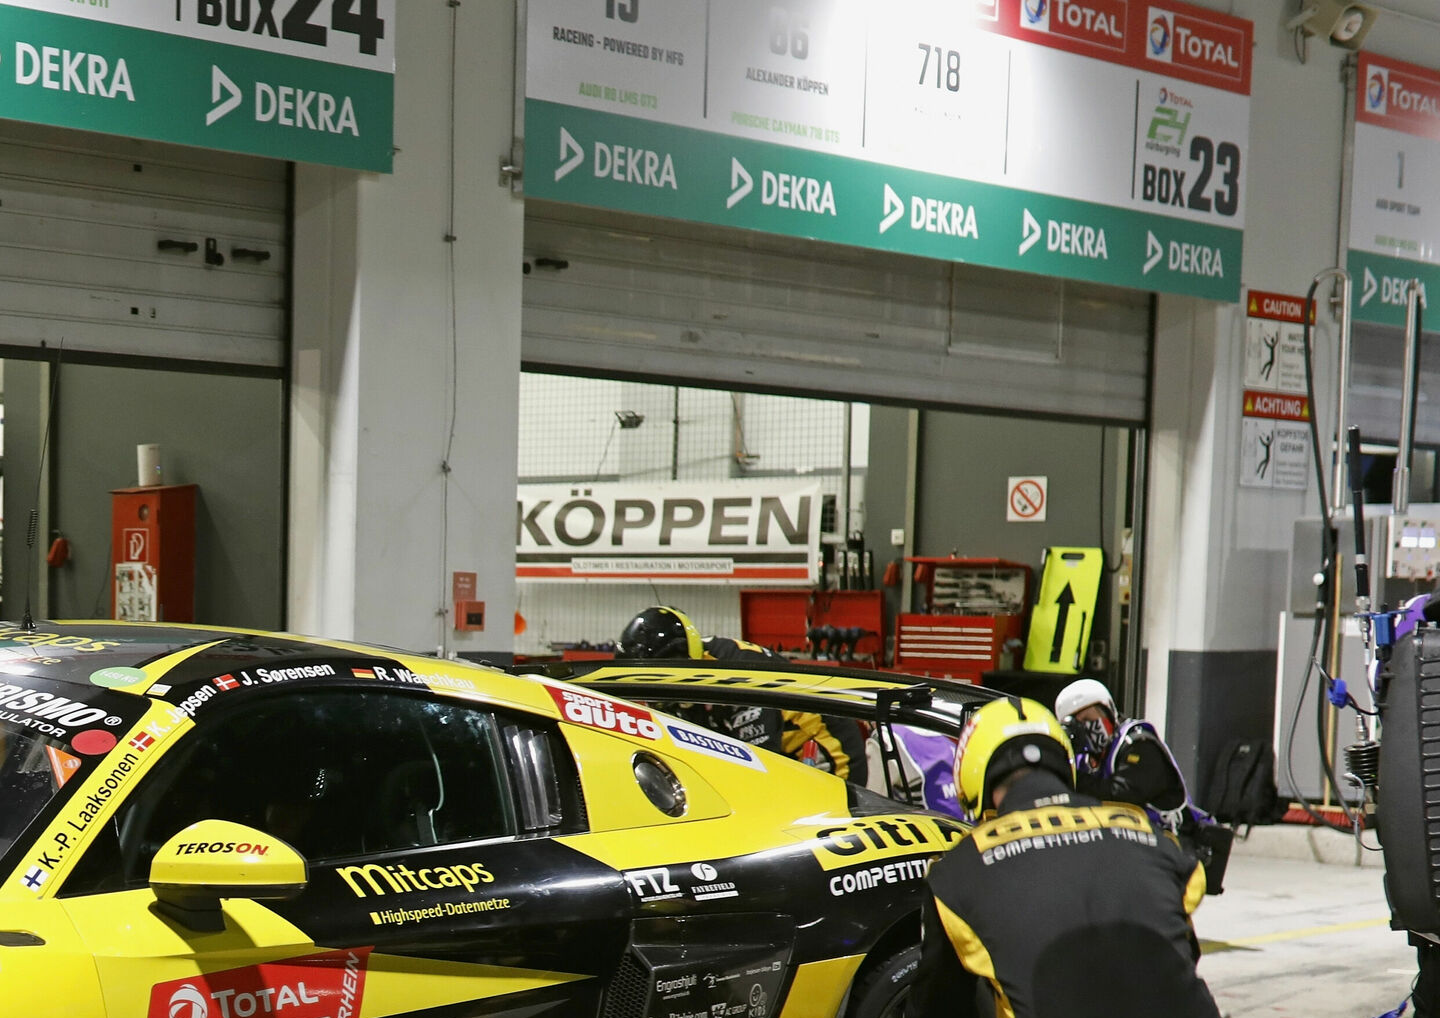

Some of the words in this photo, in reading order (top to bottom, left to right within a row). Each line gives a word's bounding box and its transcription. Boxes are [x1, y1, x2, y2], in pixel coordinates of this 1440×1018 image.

[1056, 0, 1123, 38] TOTAL
[552, 26, 594, 48] RACEING
[603, 36, 649, 59] POWERED
[651, 46, 663, 62] BY
[665, 49, 684, 66] HFG
[1176, 26, 1239, 67] TOTAL
[15, 41, 135, 102] DEKRA
[745, 66, 795, 89] ALEXANDER
[797, 76, 829, 96] KÖPPEN
[918, 43, 960, 93] 718
[254, 81, 360, 137] DEKRA
[594, 141, 677, 190] DEKRA
[1143, 163, 1186, 208] BOX
[1187, 135, 1241, 217] 23
[762, 170, 837, 217] DEKRA
[910, 195, 979, 240] DEKRA
[1047, 219, 1109, 260] DEKRA
[1168, 239, 1224, 279] DEKRA
[1263, 299, 1302, 318] CAUTION
[1381, 275, 1427, 310] DEK
[1254, 399, 1302, 417] ACHTUNG
[517, 489, 812, 547] KÖPPEN
[572, 561, 610, 571] OLDTIMER
[614, 561, 672, 571] RESTAURATION
[677, 561, 732, 571] MOTORSPORT
[241, 671, 258, 686] J.
[257, 662, 336, 685] Sørensen
[374, 665, 394, 682] R.
[394, 668, 475, 690] Waschkau
[147, 720, 171, 738] K.
[165, 683, 217, 725] Jepsen
[561, 690, 615, 712] sport
[565, 701, 663, 740] auto
[678, 728, 744, 759] BASTUCK
[37, 832, 77, 870] K.-P.
[67, 751, 139, 832] Laaksonen
[175, 842, 269, 857] TEROSON
[816, 818, 929, 856] Giti
[982, 828, 1103, 866] COMPETITION
[624, 867, 680, 897] FTZ
[380, 896, 511, 925] Highspeed-Datennetze
[748, 1005, 766, 1018] KIDS
